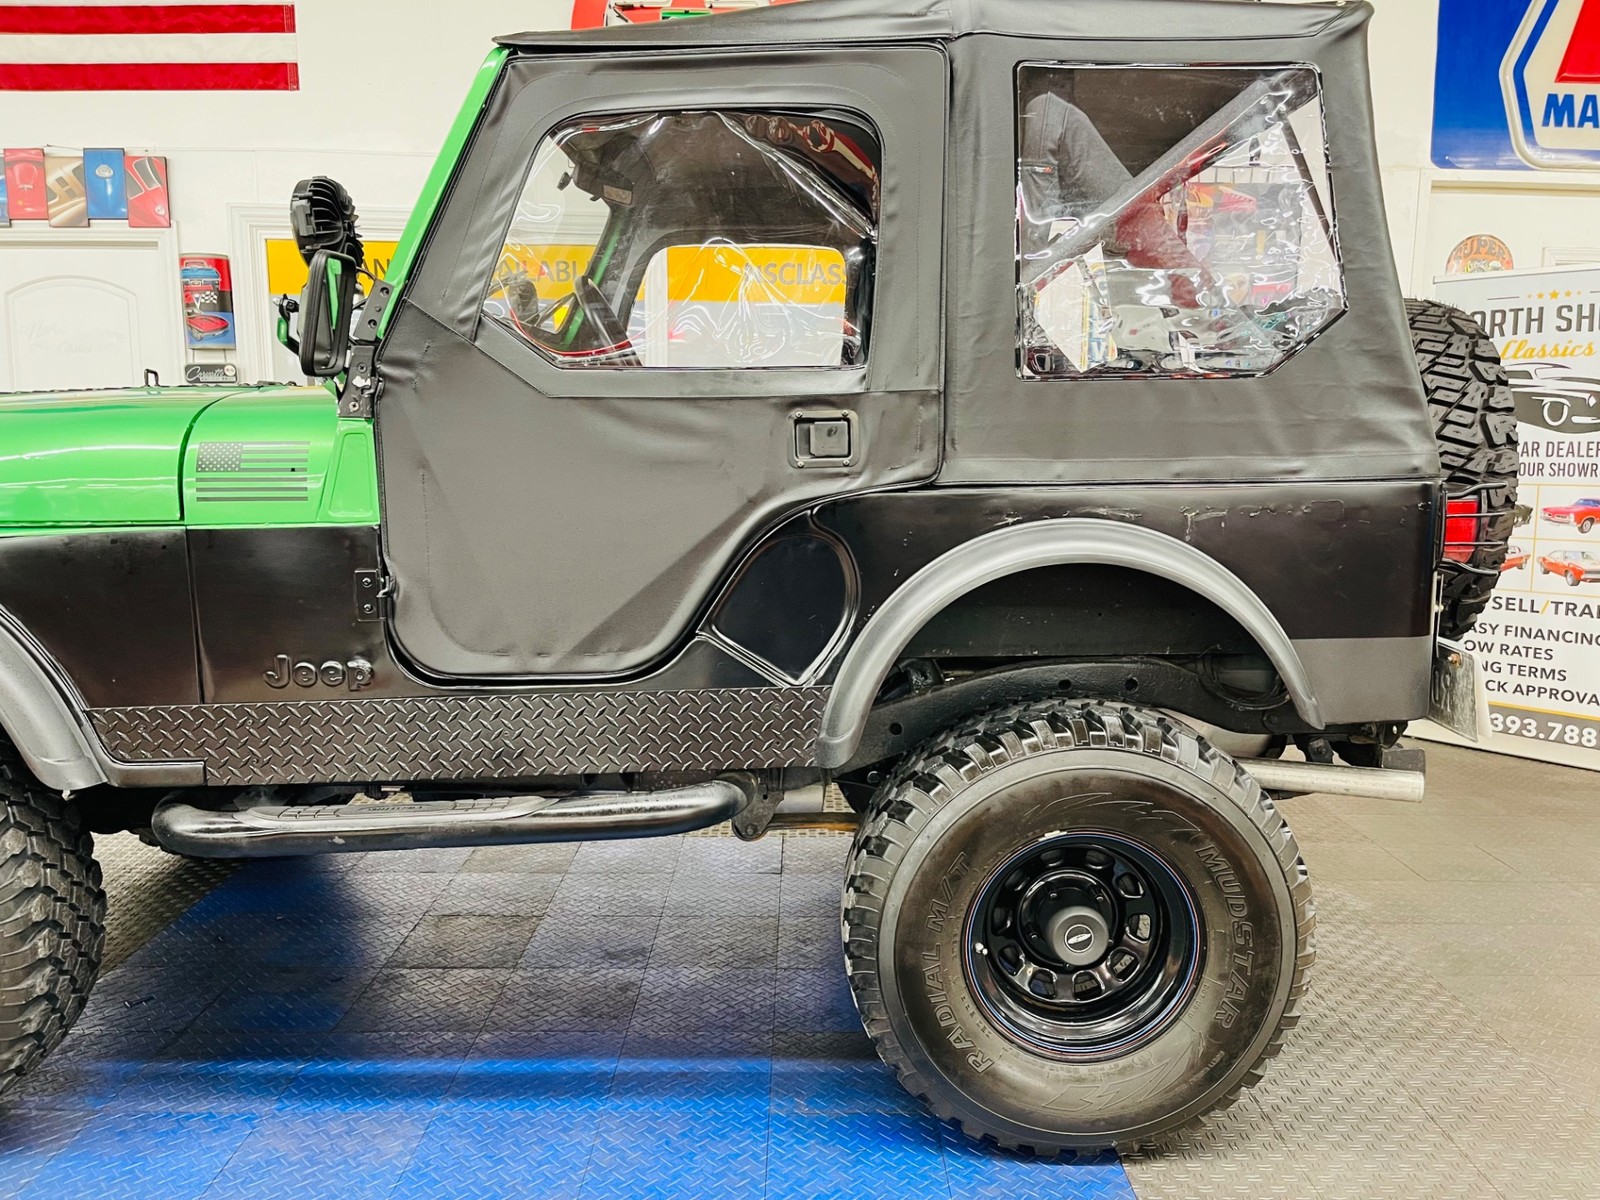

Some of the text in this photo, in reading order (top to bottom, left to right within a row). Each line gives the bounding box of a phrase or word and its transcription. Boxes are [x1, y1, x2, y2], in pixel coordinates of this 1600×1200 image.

[1542, 93, 1600, 128] MA
[1555, 303, 1600, 333] SH
[1499, 339, 1597, 360] Classics
[1518, 441, 1540, 458] AR
[1549, 462, 1599, 478] SHOWR
[1500, 643, 1553, 661] RATES
[263, 653, 375, 693] Jeep
[1507, 663, 1567, 682] TERMS
[1512, 684, 1600, 707] APPROVA
[1489, 712, 1597, 748] 393.788
[926, 851, 970, 933] M/T
[1195, 845, 1256, 1030] MUDSTAR
[922, 942, 994, 1074] RADIAL
